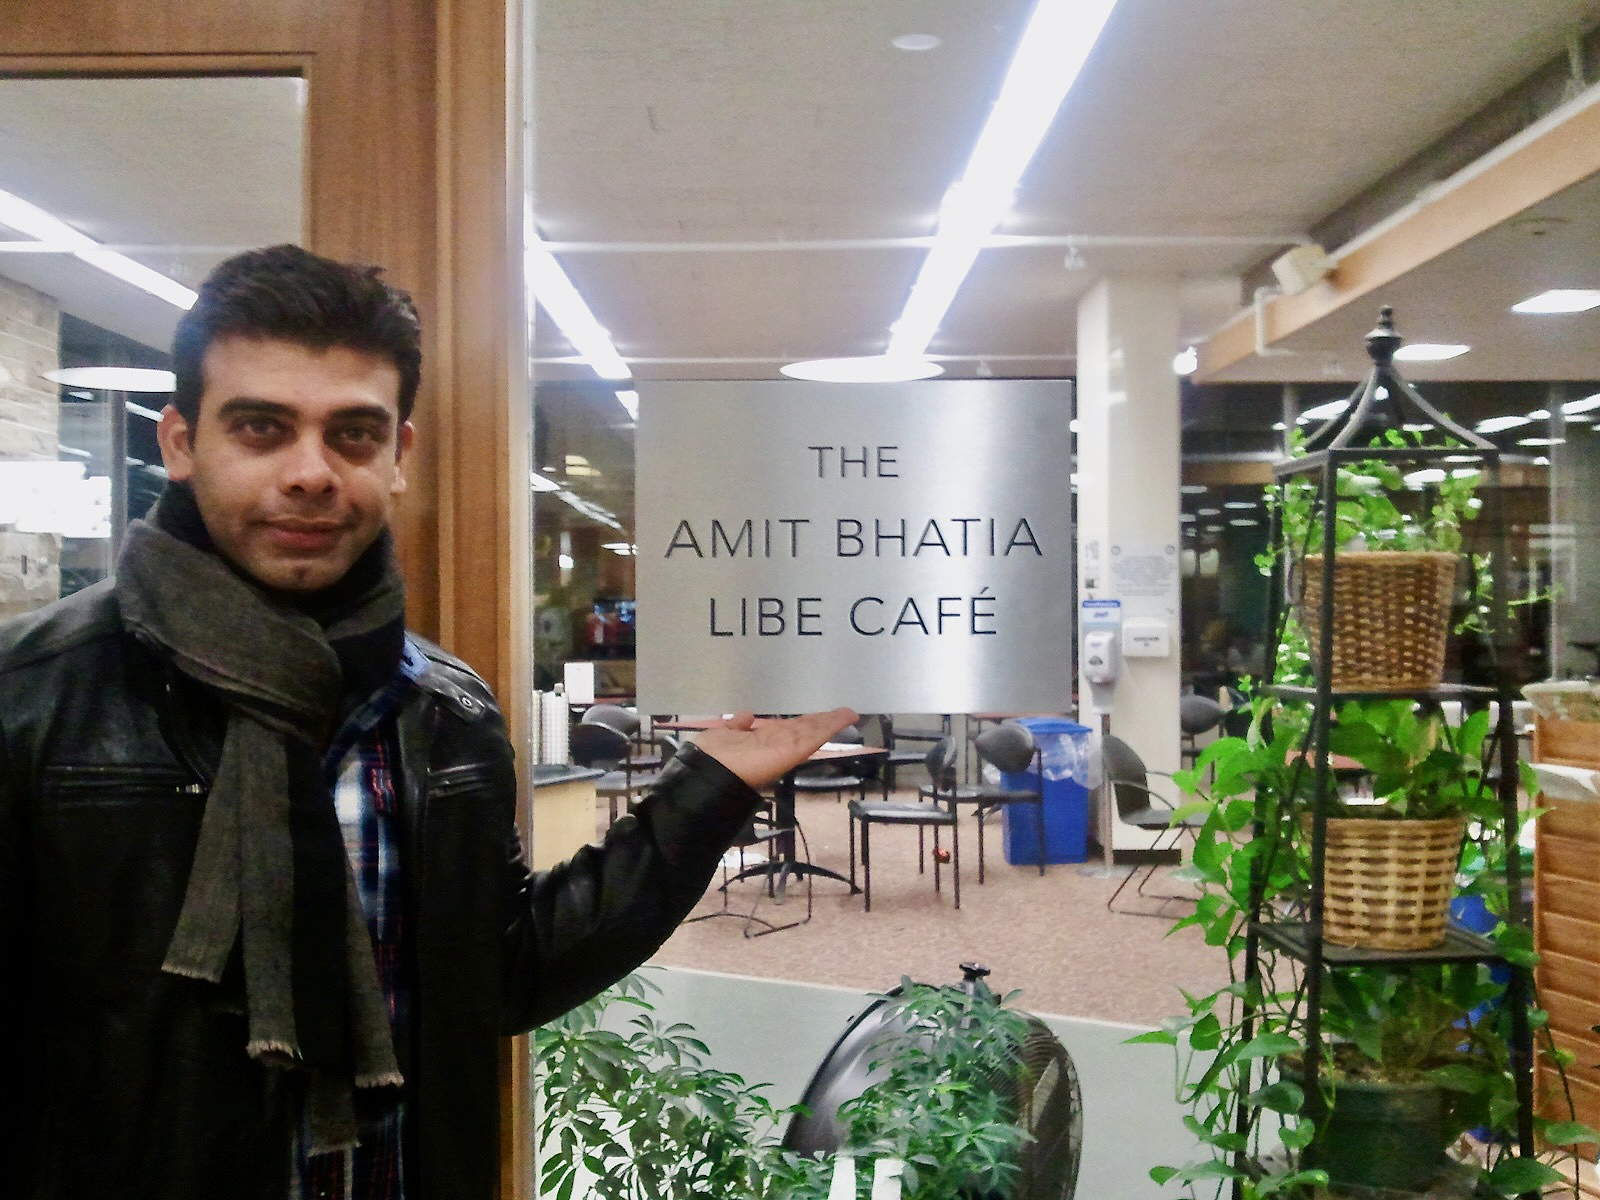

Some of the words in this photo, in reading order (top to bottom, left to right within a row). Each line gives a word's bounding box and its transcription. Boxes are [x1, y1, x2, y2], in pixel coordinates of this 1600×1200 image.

[807, 445, 900, 479] THE
[664, 518, 811, 559] AMIT
[836, 517, 1043, 558] BHATIA
[709, 597, 823, 638] LIBE
[849, 586, 997, 637] CAFÉ
